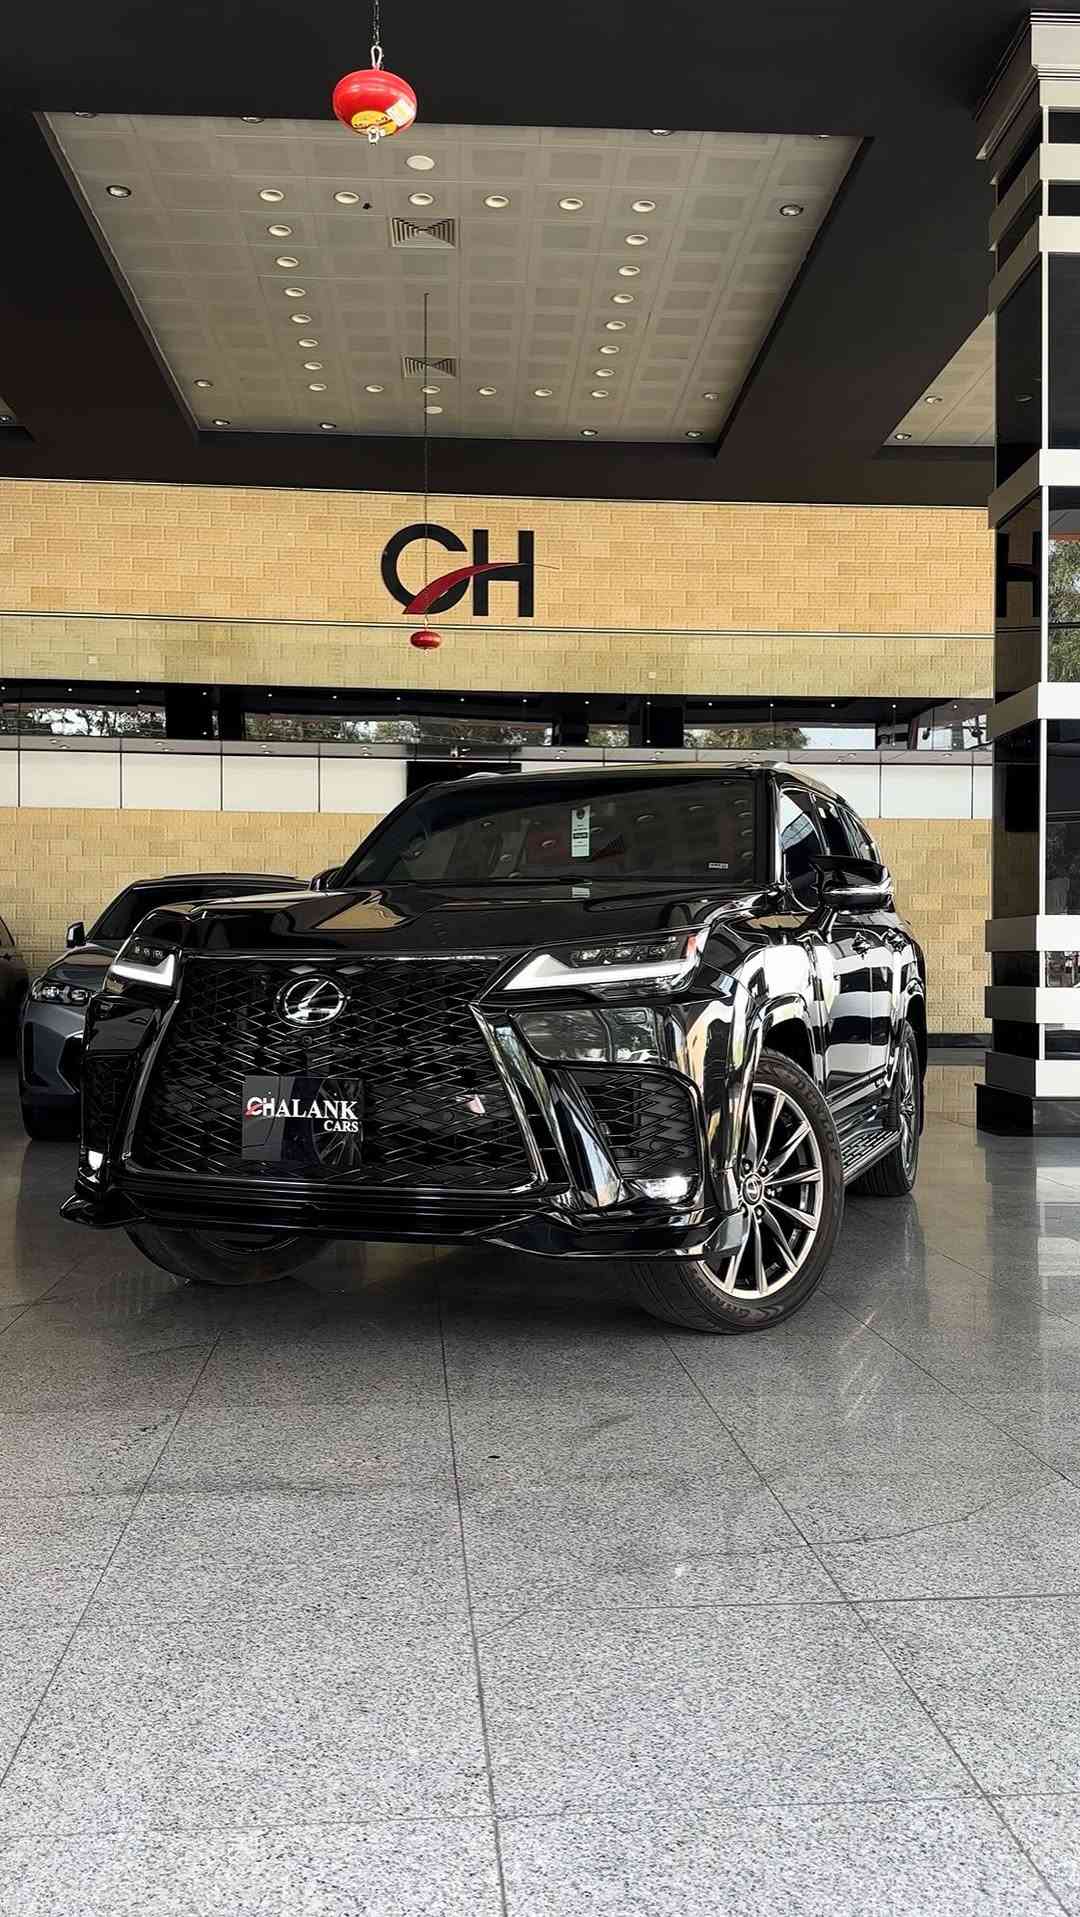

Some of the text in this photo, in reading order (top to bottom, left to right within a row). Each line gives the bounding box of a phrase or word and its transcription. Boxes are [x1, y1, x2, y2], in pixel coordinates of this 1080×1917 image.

[380, 522, 535, 618] CH
[244, 1096, 359, 1120] CHALANK
[323, 1119, 359, 1132] CARS
